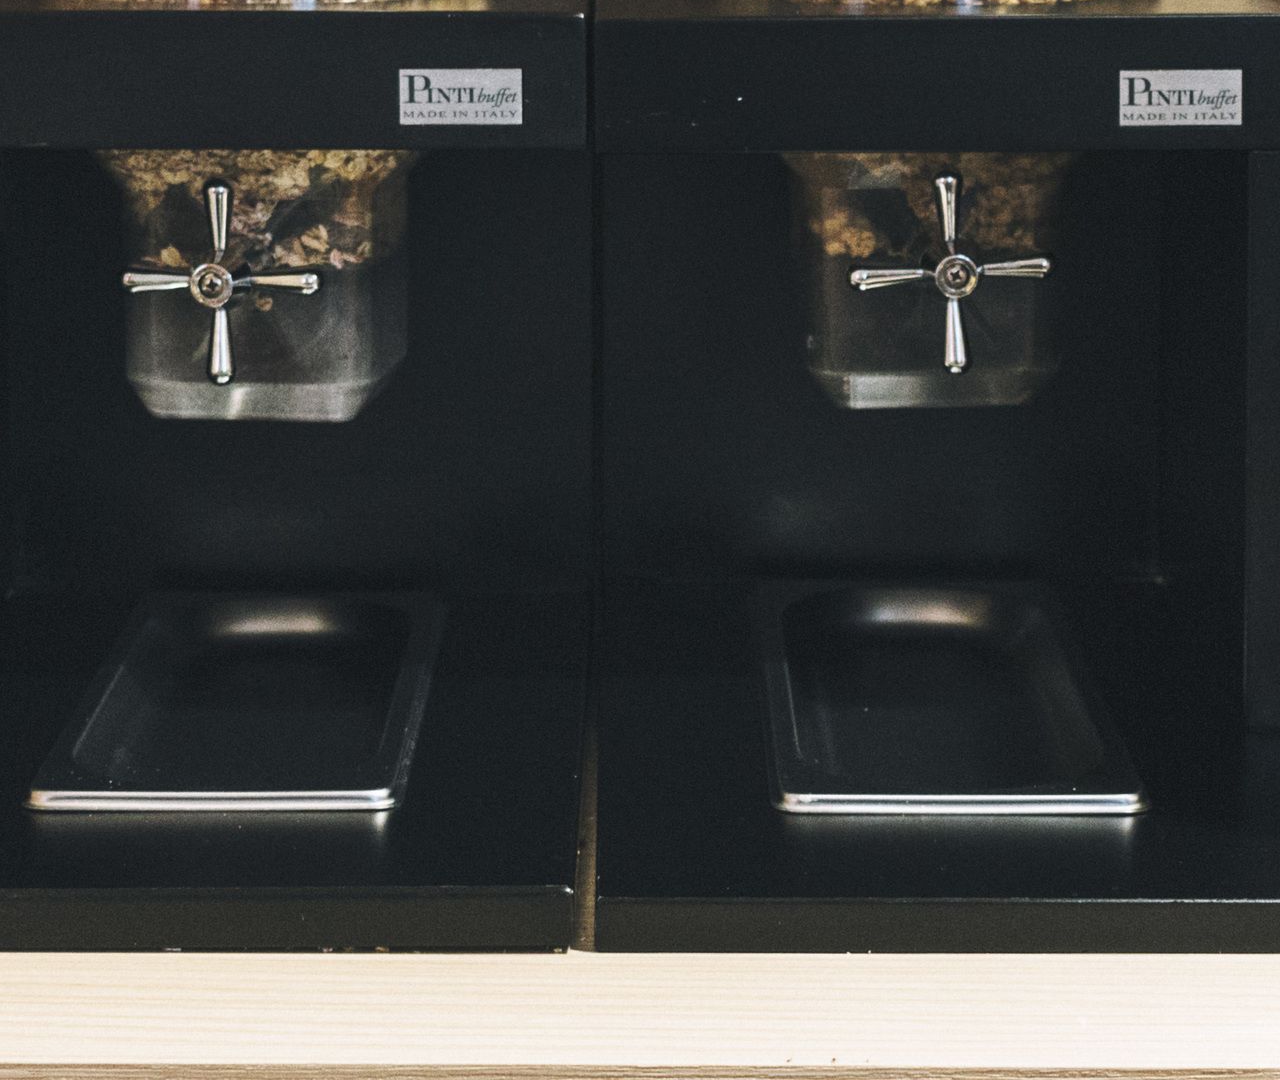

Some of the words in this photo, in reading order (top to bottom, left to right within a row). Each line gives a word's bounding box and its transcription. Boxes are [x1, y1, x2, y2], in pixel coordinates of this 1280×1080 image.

[402, 74, 476, 104] PINTI
[476, 87, 518, 108] buffet
[1122, 77, 1196, 106] PINTI
[1197, 89, 1238, 110] buffet
[403, 110, 447, 119] MADE
[453, 110, 468, 119] IN
[475, 110, 518, 119] ITALY
[1123, 112, 1167, 121] MADE
[1173, 112, 1188, 121] IN
[1195, 112, 1237, 121] ITALY
